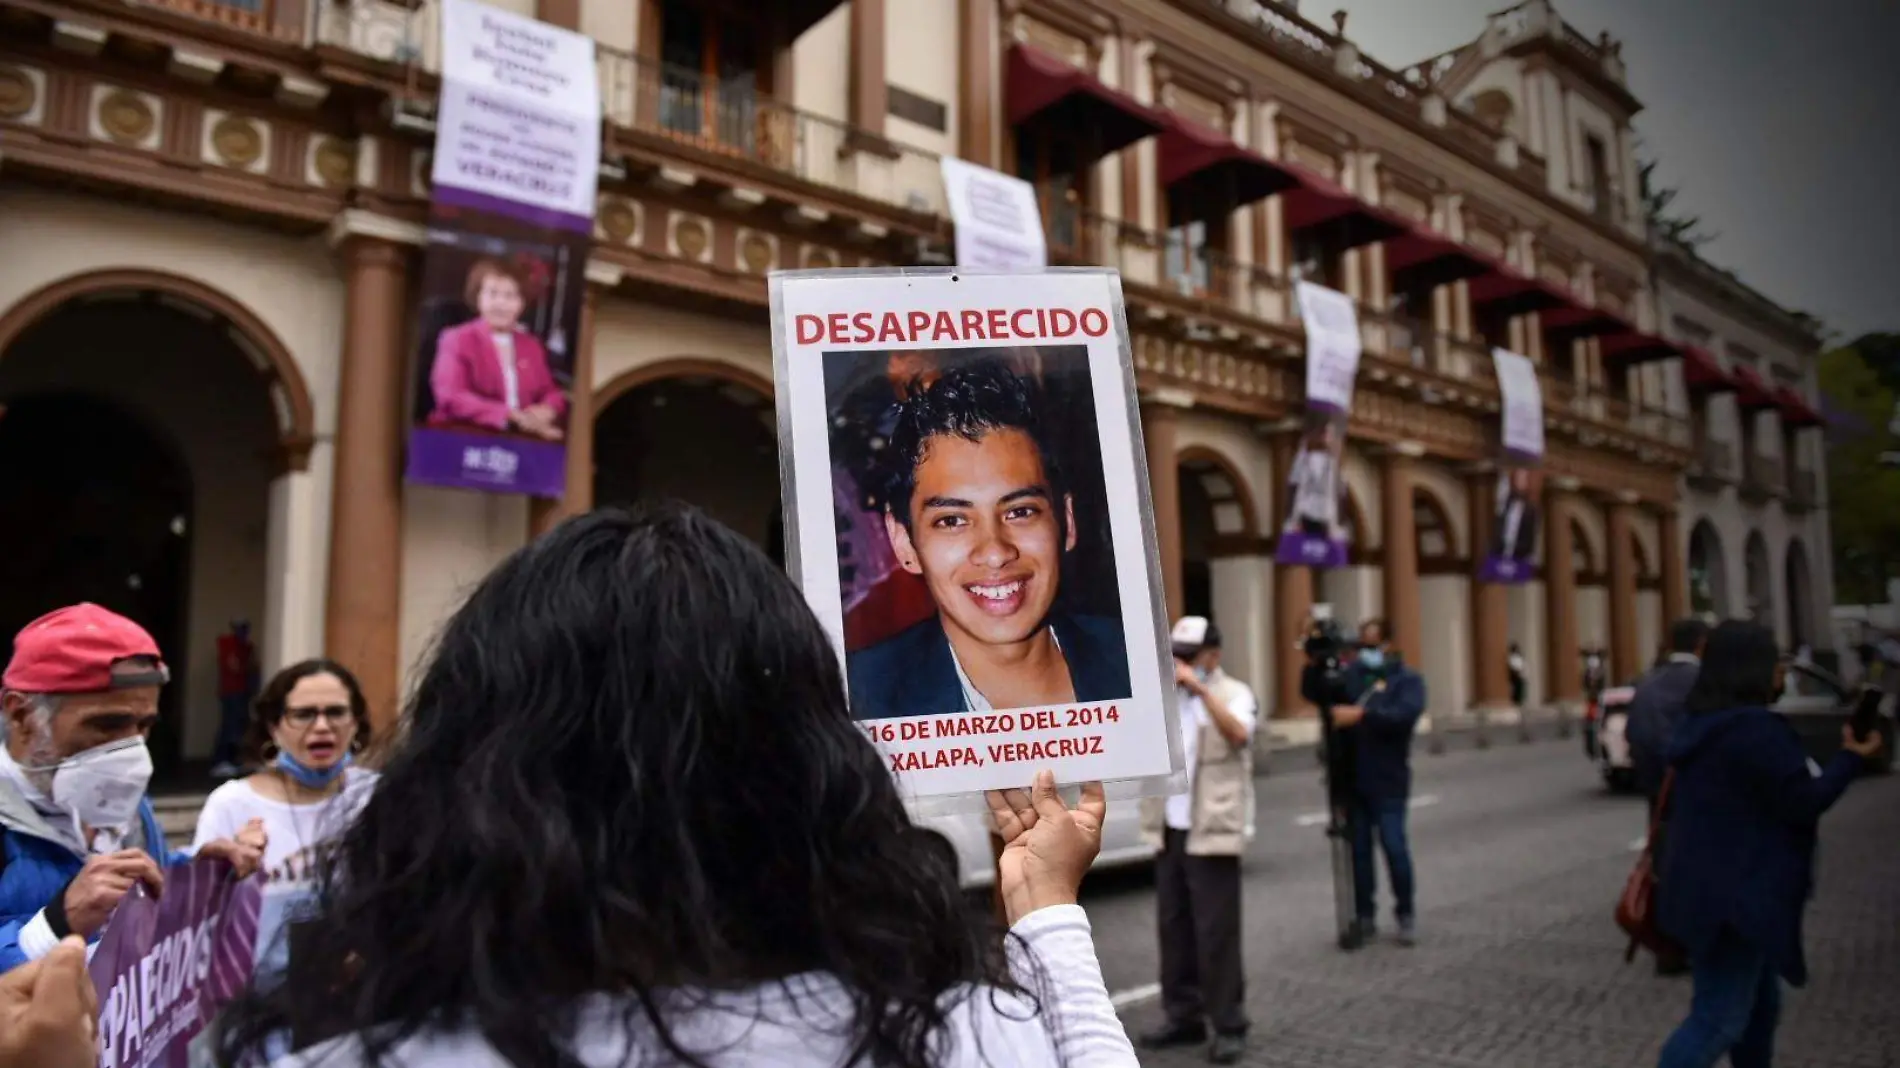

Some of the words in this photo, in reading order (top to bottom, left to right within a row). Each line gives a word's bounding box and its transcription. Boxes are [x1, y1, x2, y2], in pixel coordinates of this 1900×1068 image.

[795, 308, 1108, 345] DESAPARECIDO
[868, 724, 895, 742] 16
[901, 721, 930, 741] DE
[935, 714, 1014, 738] MARZO
[1020, 711, 1060, 731] DEL
[1066, 705, 1120, 727] 2014
[890, 747, 984, 772] XALAPA,
[987, 736, 1104, 762] VERACRUZ
